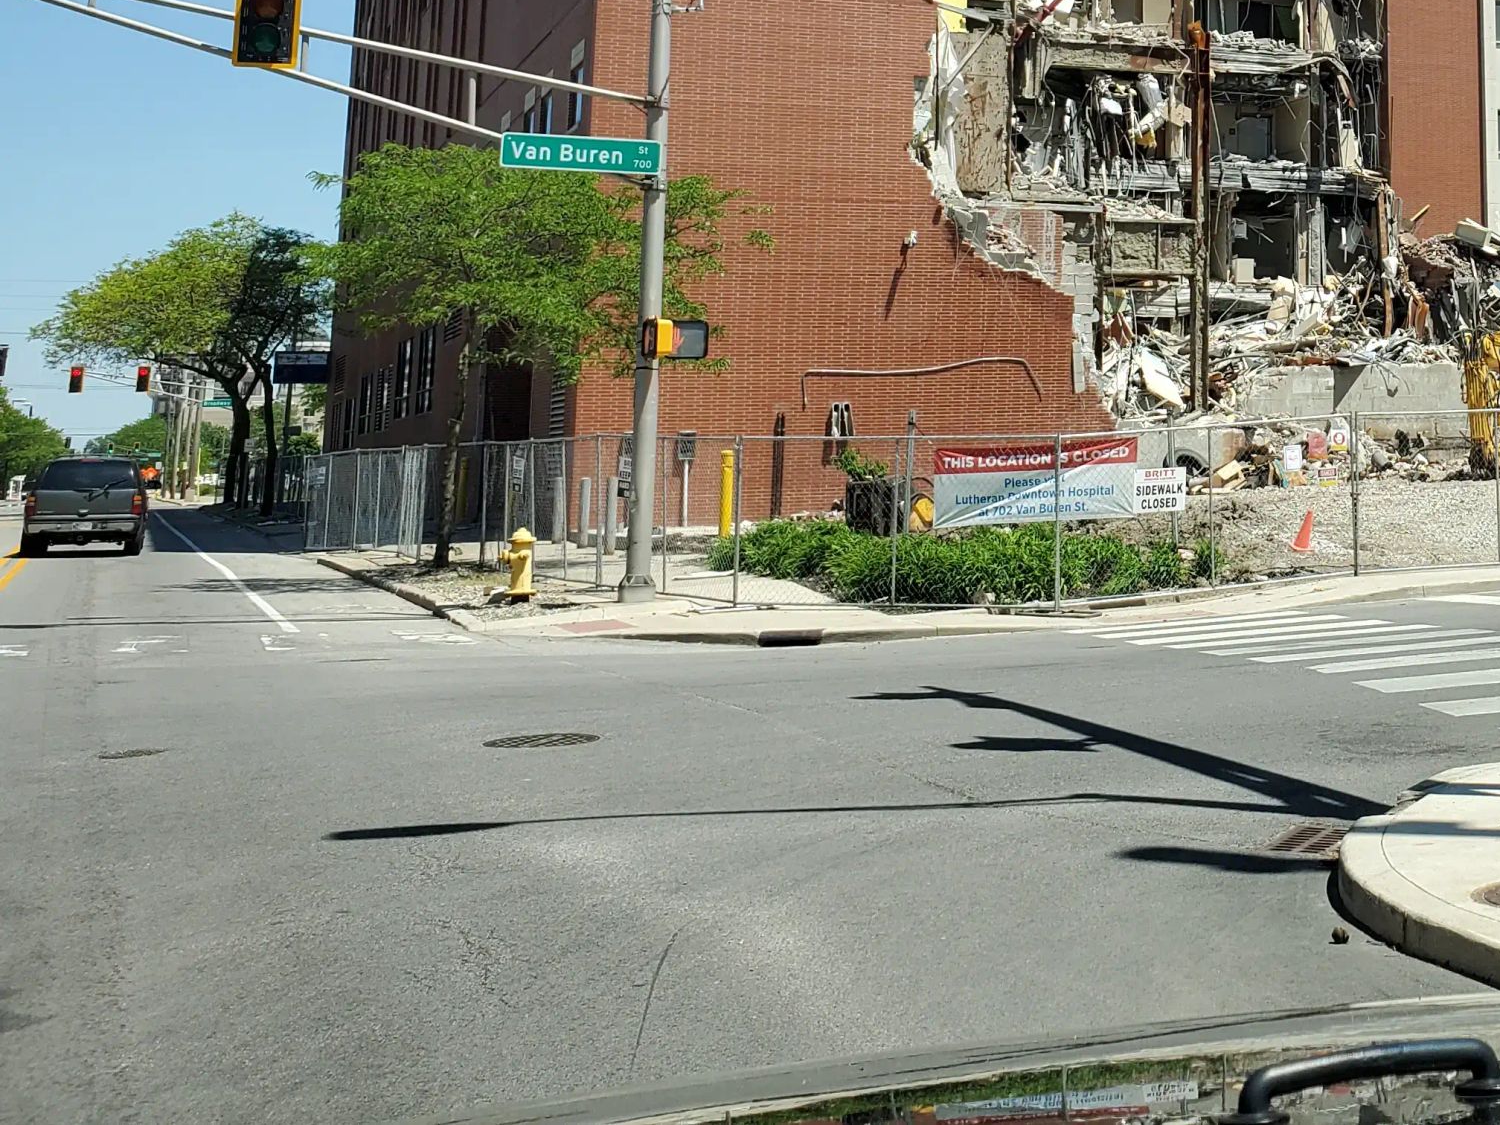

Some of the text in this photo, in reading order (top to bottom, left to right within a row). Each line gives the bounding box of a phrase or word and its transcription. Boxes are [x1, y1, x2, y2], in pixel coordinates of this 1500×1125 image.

[511, 141, 649, 165] Van Buren St
[632, 159, 652, 169] 700
[942, 456, 975, 469] THIS
[978, 453, 1052, 467] LOCATION
[1073, 446, 1130, 462] CLOSED
[1144, 469, 1176, 477] BRITT
[1004, 477, 1041, 488] Please
[955, 493, 1005, 505] Lutheran
[1068, 484, 1114, 498] Hospital
[1136, 483, 1183, 497] SIDEWALK
[978, 509, 989, 517] at
[993, 505, 1013, 516] 702
[1016, 505, 1036, 515] Van
[1074, 501, 1089, 512] St.
[1141, 497, 1177, 510] CLOSED
